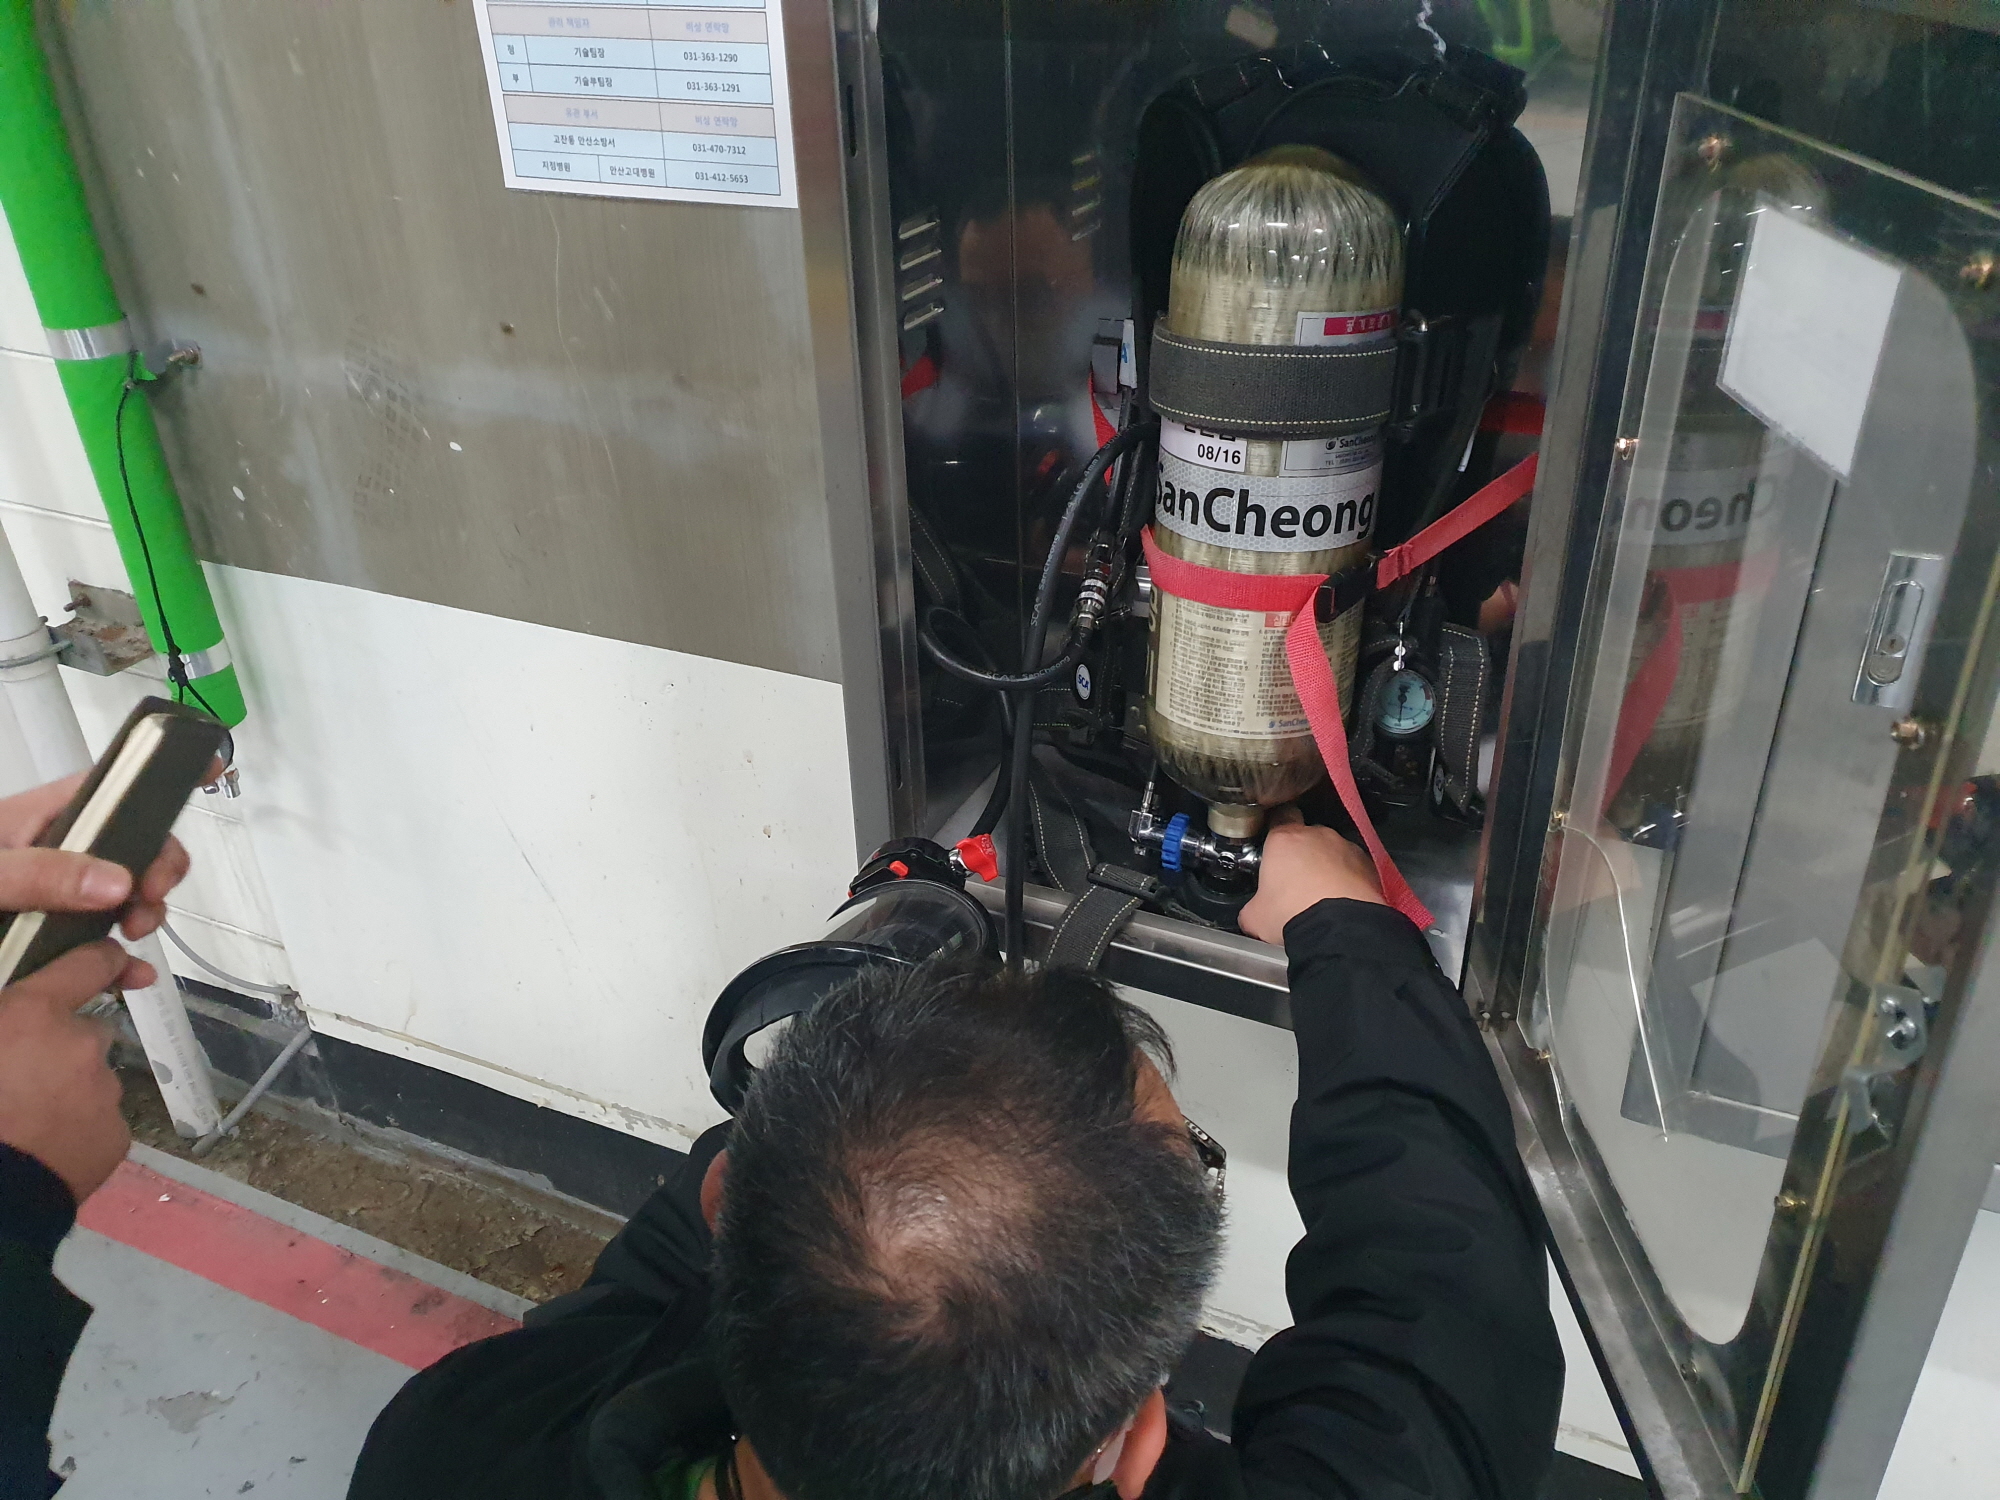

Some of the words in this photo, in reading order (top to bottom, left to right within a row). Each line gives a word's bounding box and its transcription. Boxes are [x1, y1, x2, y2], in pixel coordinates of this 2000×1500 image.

[685, 21, 702, 33] 비상
[705, 22, 730, 34] 연락망
[507, 44, 515, 56] 정
[574, 47, 605, 59] 기술팀장
[683, 52, 738, 63] 031-363-1290
[574, 76, 613, 88] 기술부팀장
[686, 81, 741, 93] 031-363-1291
[695, 115, 711, 126] 비상
[713, 116, 739, 128] 연락망
[577, 136, 616, 148] 안산소방서
[692, 143, 747, 155] 031-470-7312
[542, 160, 571, 173] 지정병원
[610, 165, 656, 179] 안산고대병원
[695, 171, 749, 184] 031-412-5653
[1197, 443, 1241, 465] 08/16
[1078, 674, 1090, 691] SCA
